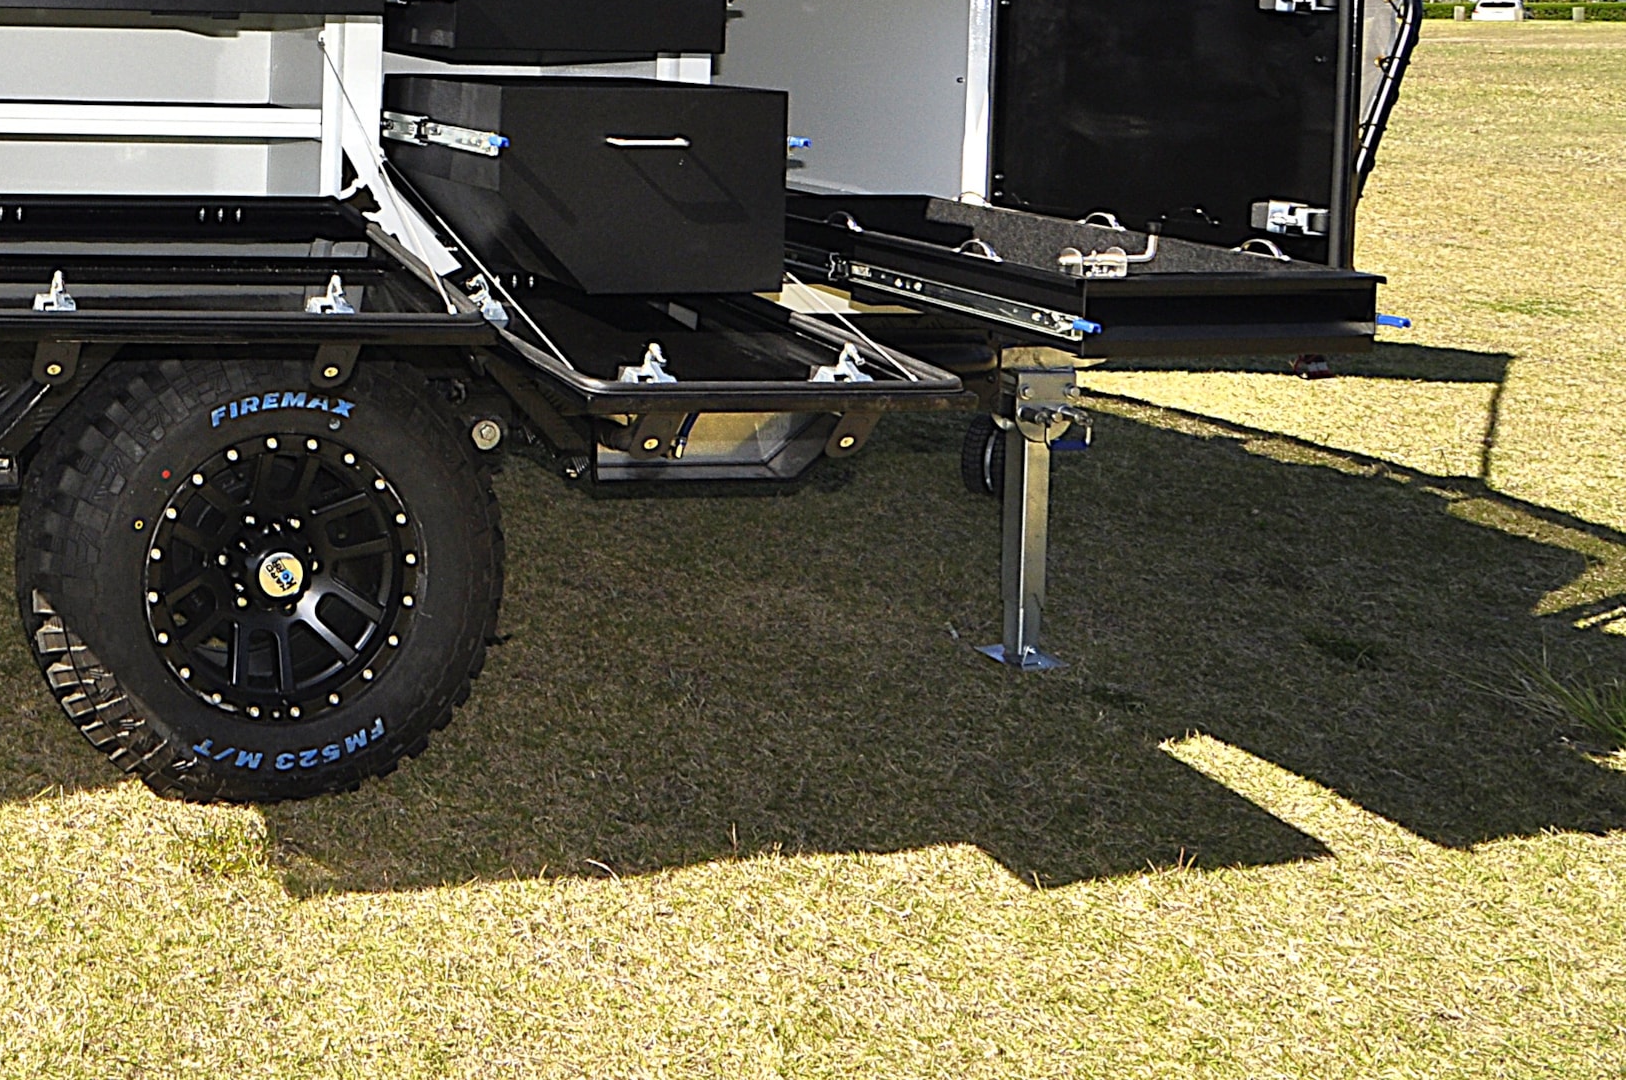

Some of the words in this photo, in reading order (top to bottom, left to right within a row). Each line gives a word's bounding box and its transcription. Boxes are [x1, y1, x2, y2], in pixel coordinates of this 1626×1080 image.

[210, 391, 356, 428] FIREMAX
[192, 738, 263, 769] M/T
[275, 717, 386, 771] FM523
